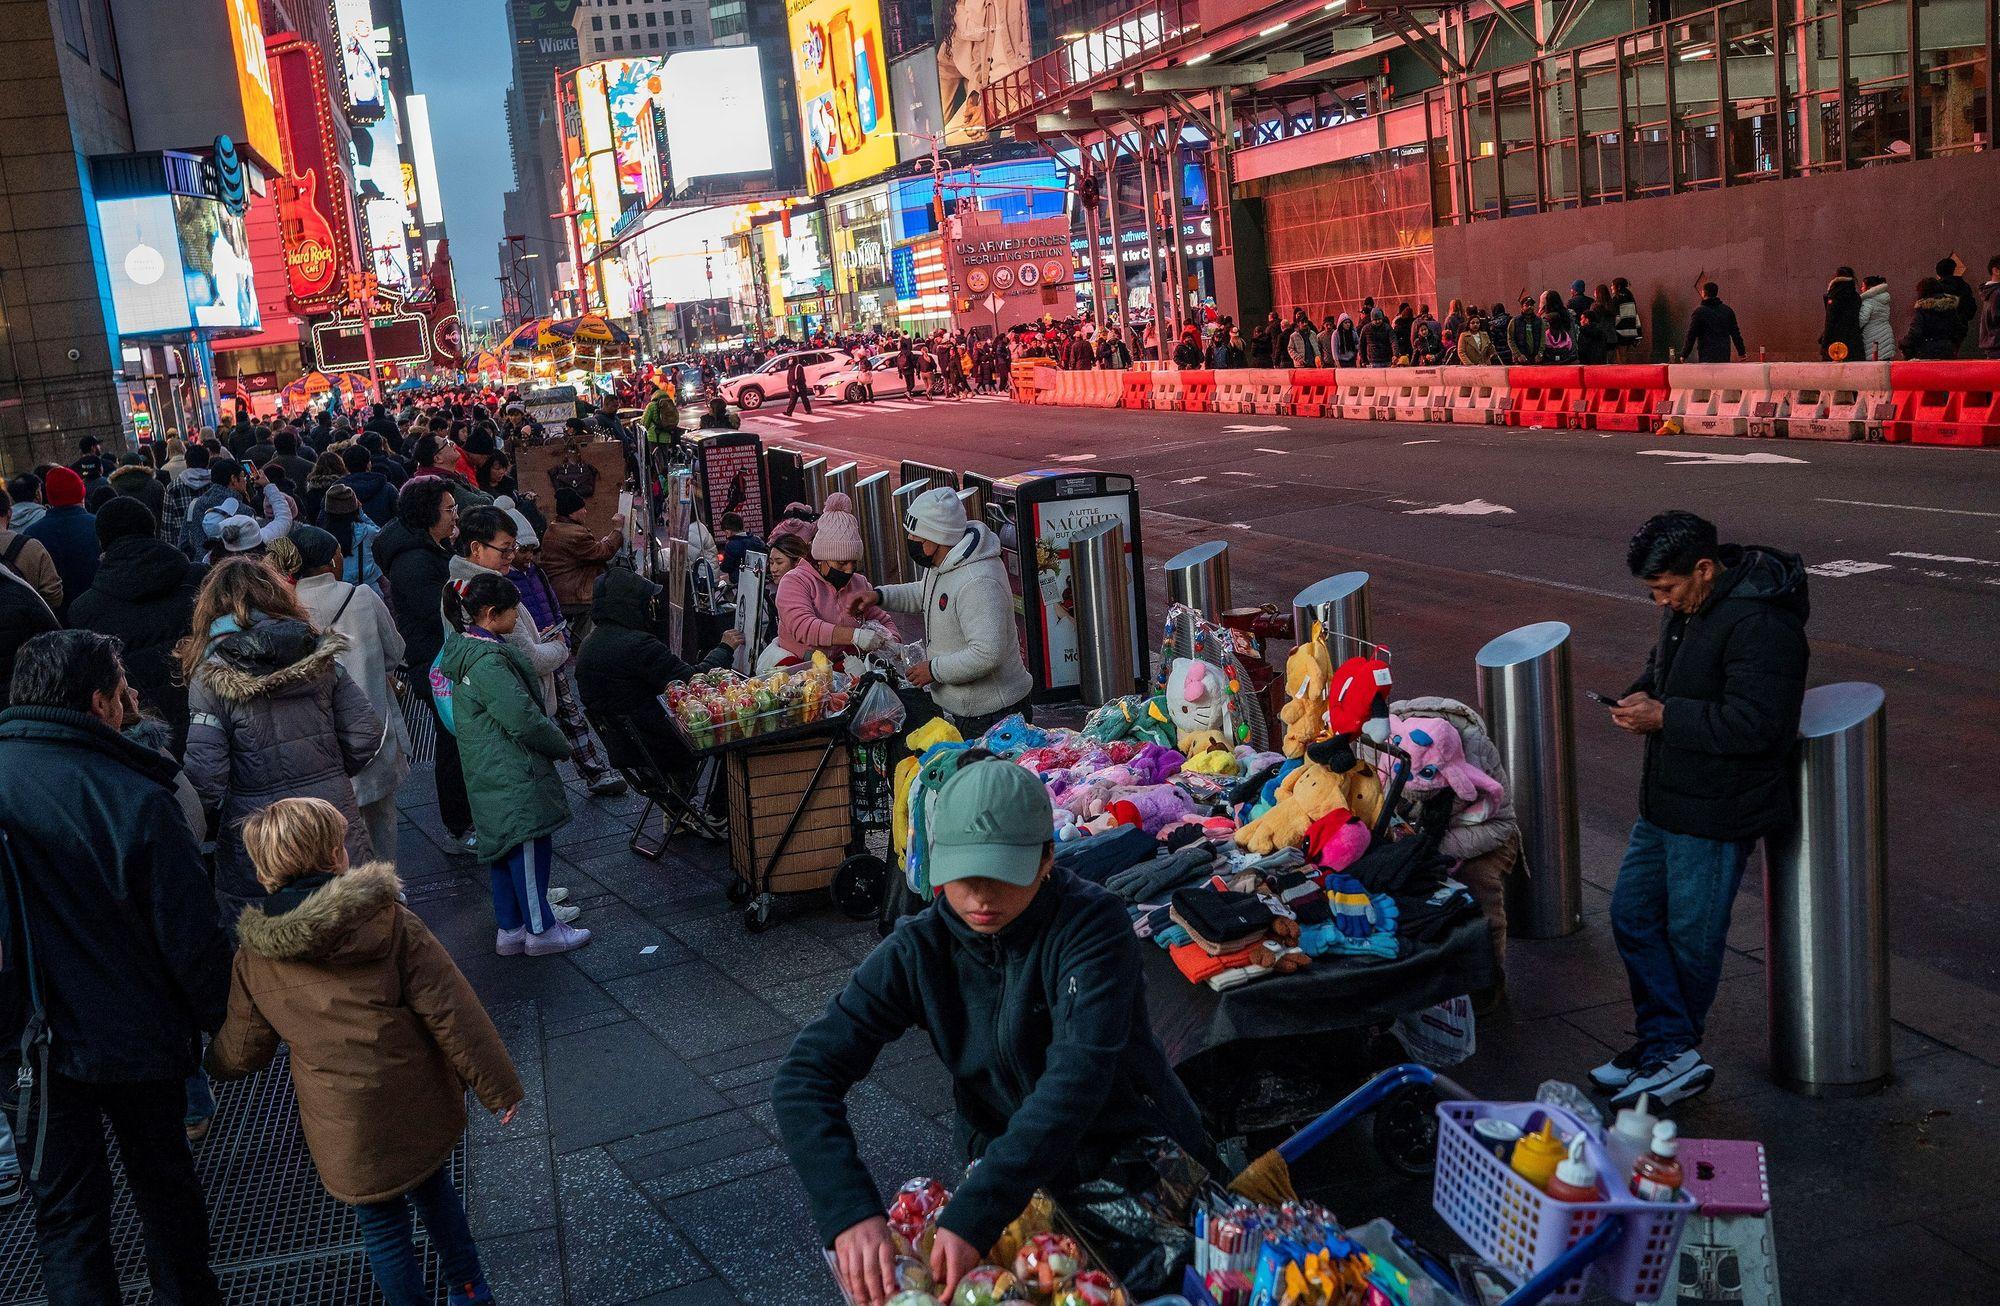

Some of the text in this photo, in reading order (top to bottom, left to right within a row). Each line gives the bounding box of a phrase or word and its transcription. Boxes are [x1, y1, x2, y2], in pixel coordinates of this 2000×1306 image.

[539, 38, 578, 53] WICKE
[957, 235, 1067, 255] U.S. ARMED FORCES
[288, 246, 333, 266] Hard Rock
[842, 249, 858, 269] OLD
[858, 243, 881, 267] NAVY
[963, 247, 1063, 266] RECRUITING STATION
[1129, 250, 1142, 261] for
[706, 453, 729, 461] SMOOTH
[737, 509, 763, 517] NATURE
[1076, 507, 1099, 516] LITTLE
[1056, 531, 1070, 539] BUT
